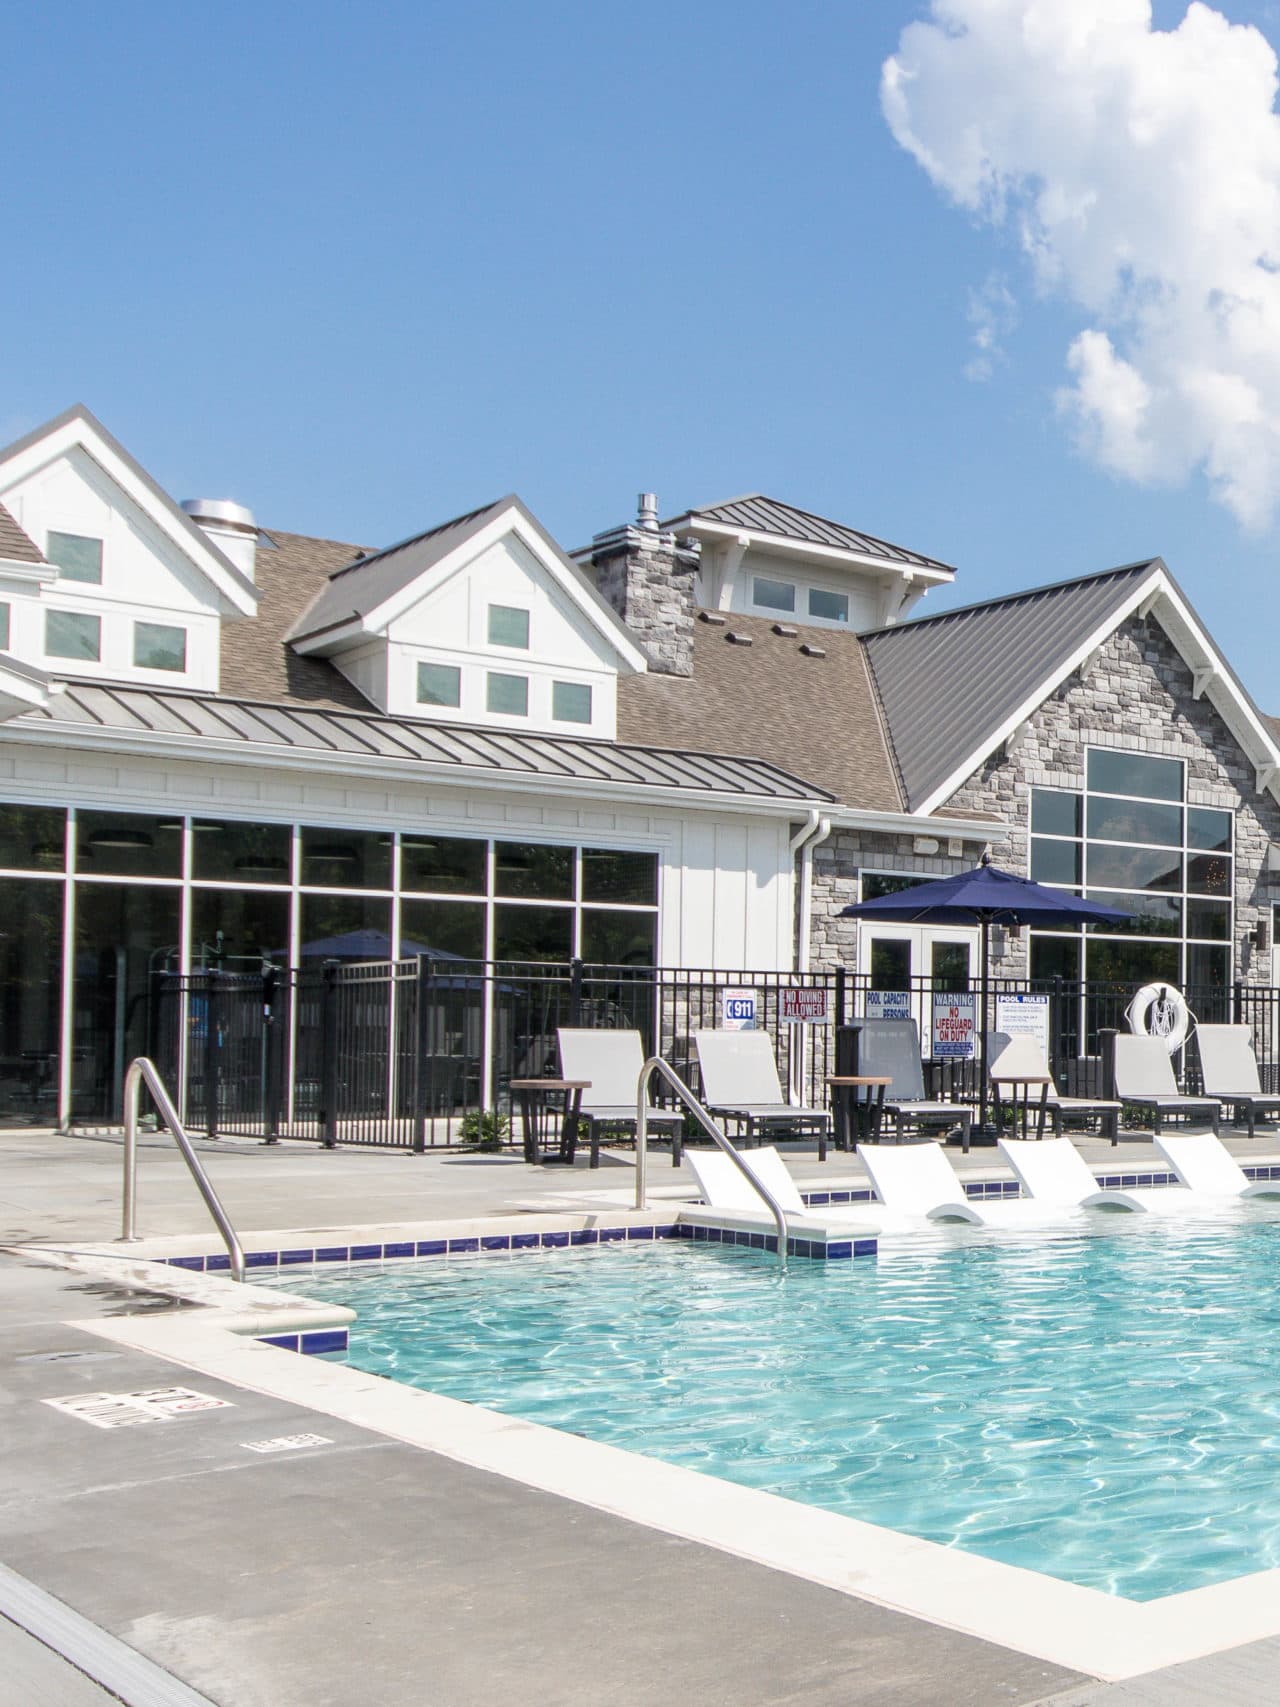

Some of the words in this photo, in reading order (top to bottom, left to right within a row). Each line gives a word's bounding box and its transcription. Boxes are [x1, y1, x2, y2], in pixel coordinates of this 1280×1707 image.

[786, 990, 796, 1003] NO
[799, 990, 823, 1004] DIVING
[867, 991, 881, 1005] POOL
[883, 992, 909, 1006] CAPACITY
[936, 993, 974, 1006] WARNING
[1000, 995, 1020, 1003] POOL
[1022, 996, 1046, 1004] RULES
[735, 1001, 751, 1017] 911
[787, 1003, 823, 1016] ALLOWED
[883, 1008, 909, 1018] PERSONS
[950, 1007, 959, 1018] NO
[936, 1018, 972, 1030] LIFEGUARD
[940, 1030, 949, 1041] ON
[951, 1030, 968, 1042] DUTY
